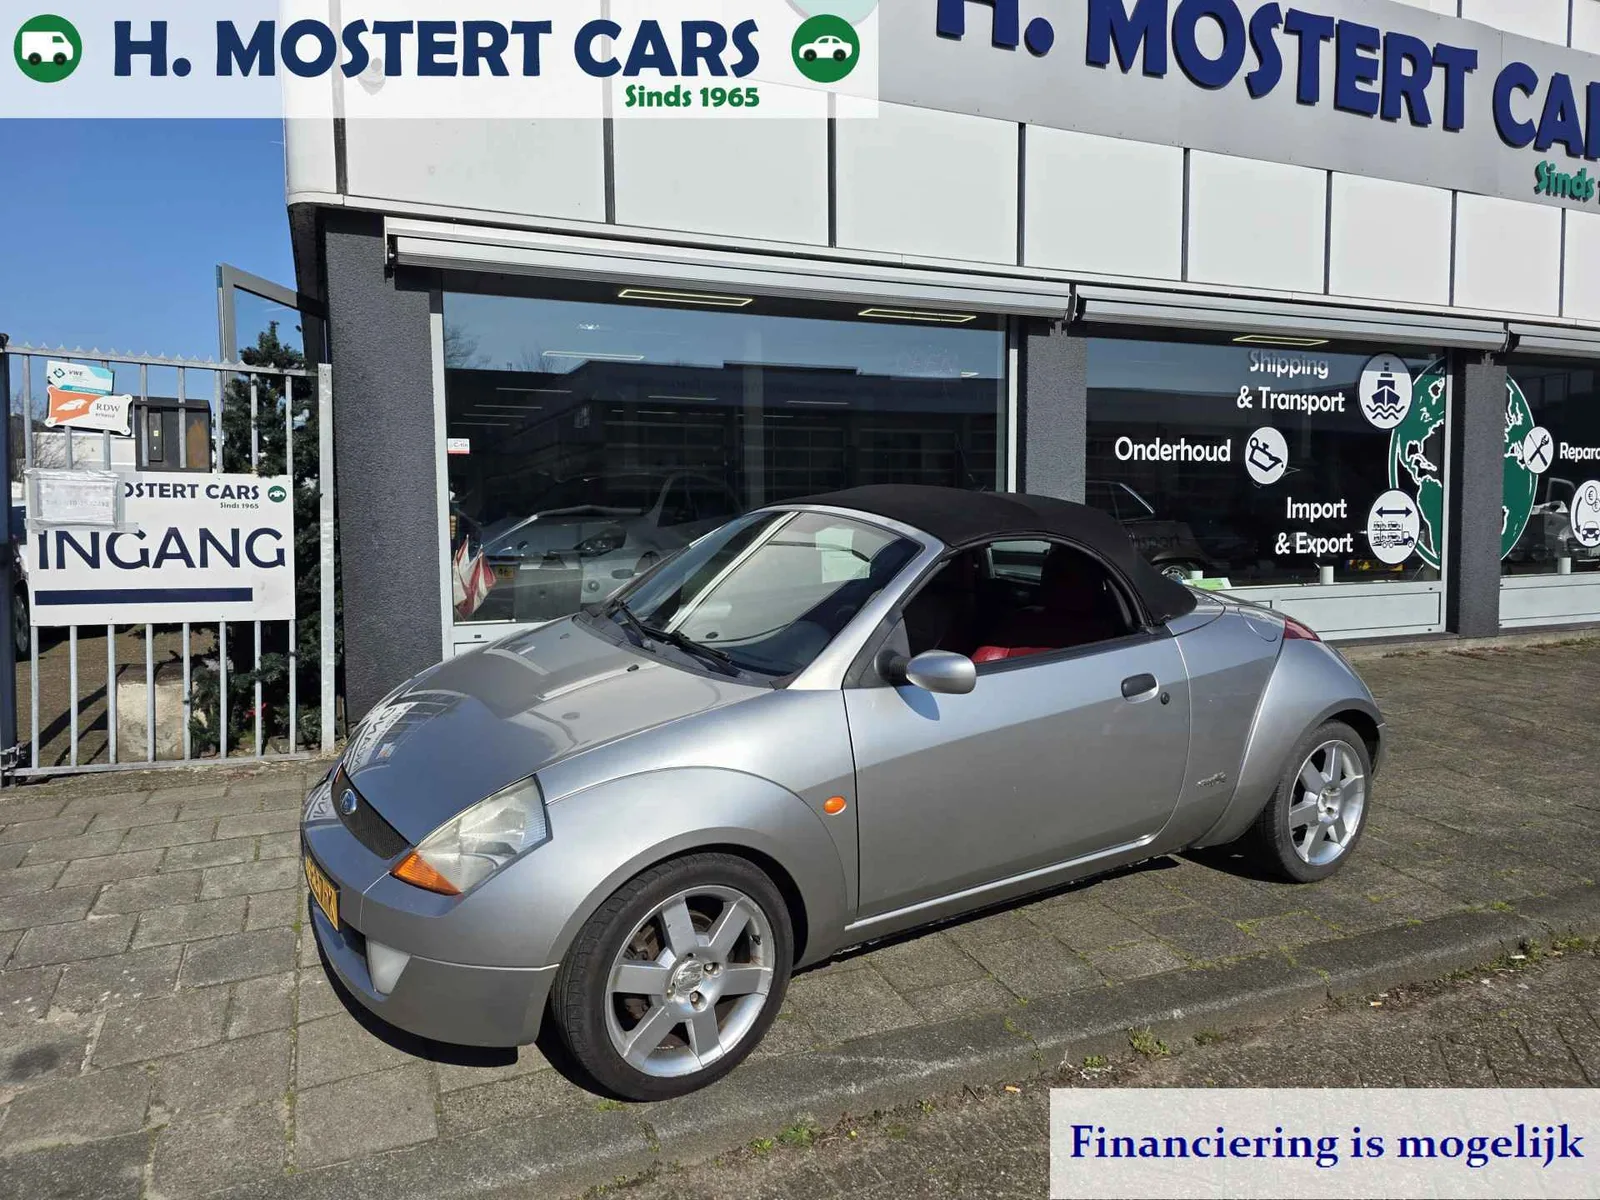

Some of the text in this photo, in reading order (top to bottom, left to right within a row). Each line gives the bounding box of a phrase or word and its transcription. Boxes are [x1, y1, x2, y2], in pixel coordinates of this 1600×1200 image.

[1085, 0, 1478, 132] MOSTERT
[1534, 160, 1595, 203] Sinds
[1249, 350, 1329, 380] Shipping
[96, 403, 120, 412] RDW
[1237, 385, 1346, 414] & Transport
[1115, 436, 1232, 463] Onderhoud
[206, 485, 260, 500] CARS
[1287, 496, 1347, 522] Import
[38, 527, 286, 570] INGANG
[1275, 531, 1354, 557] & Export
